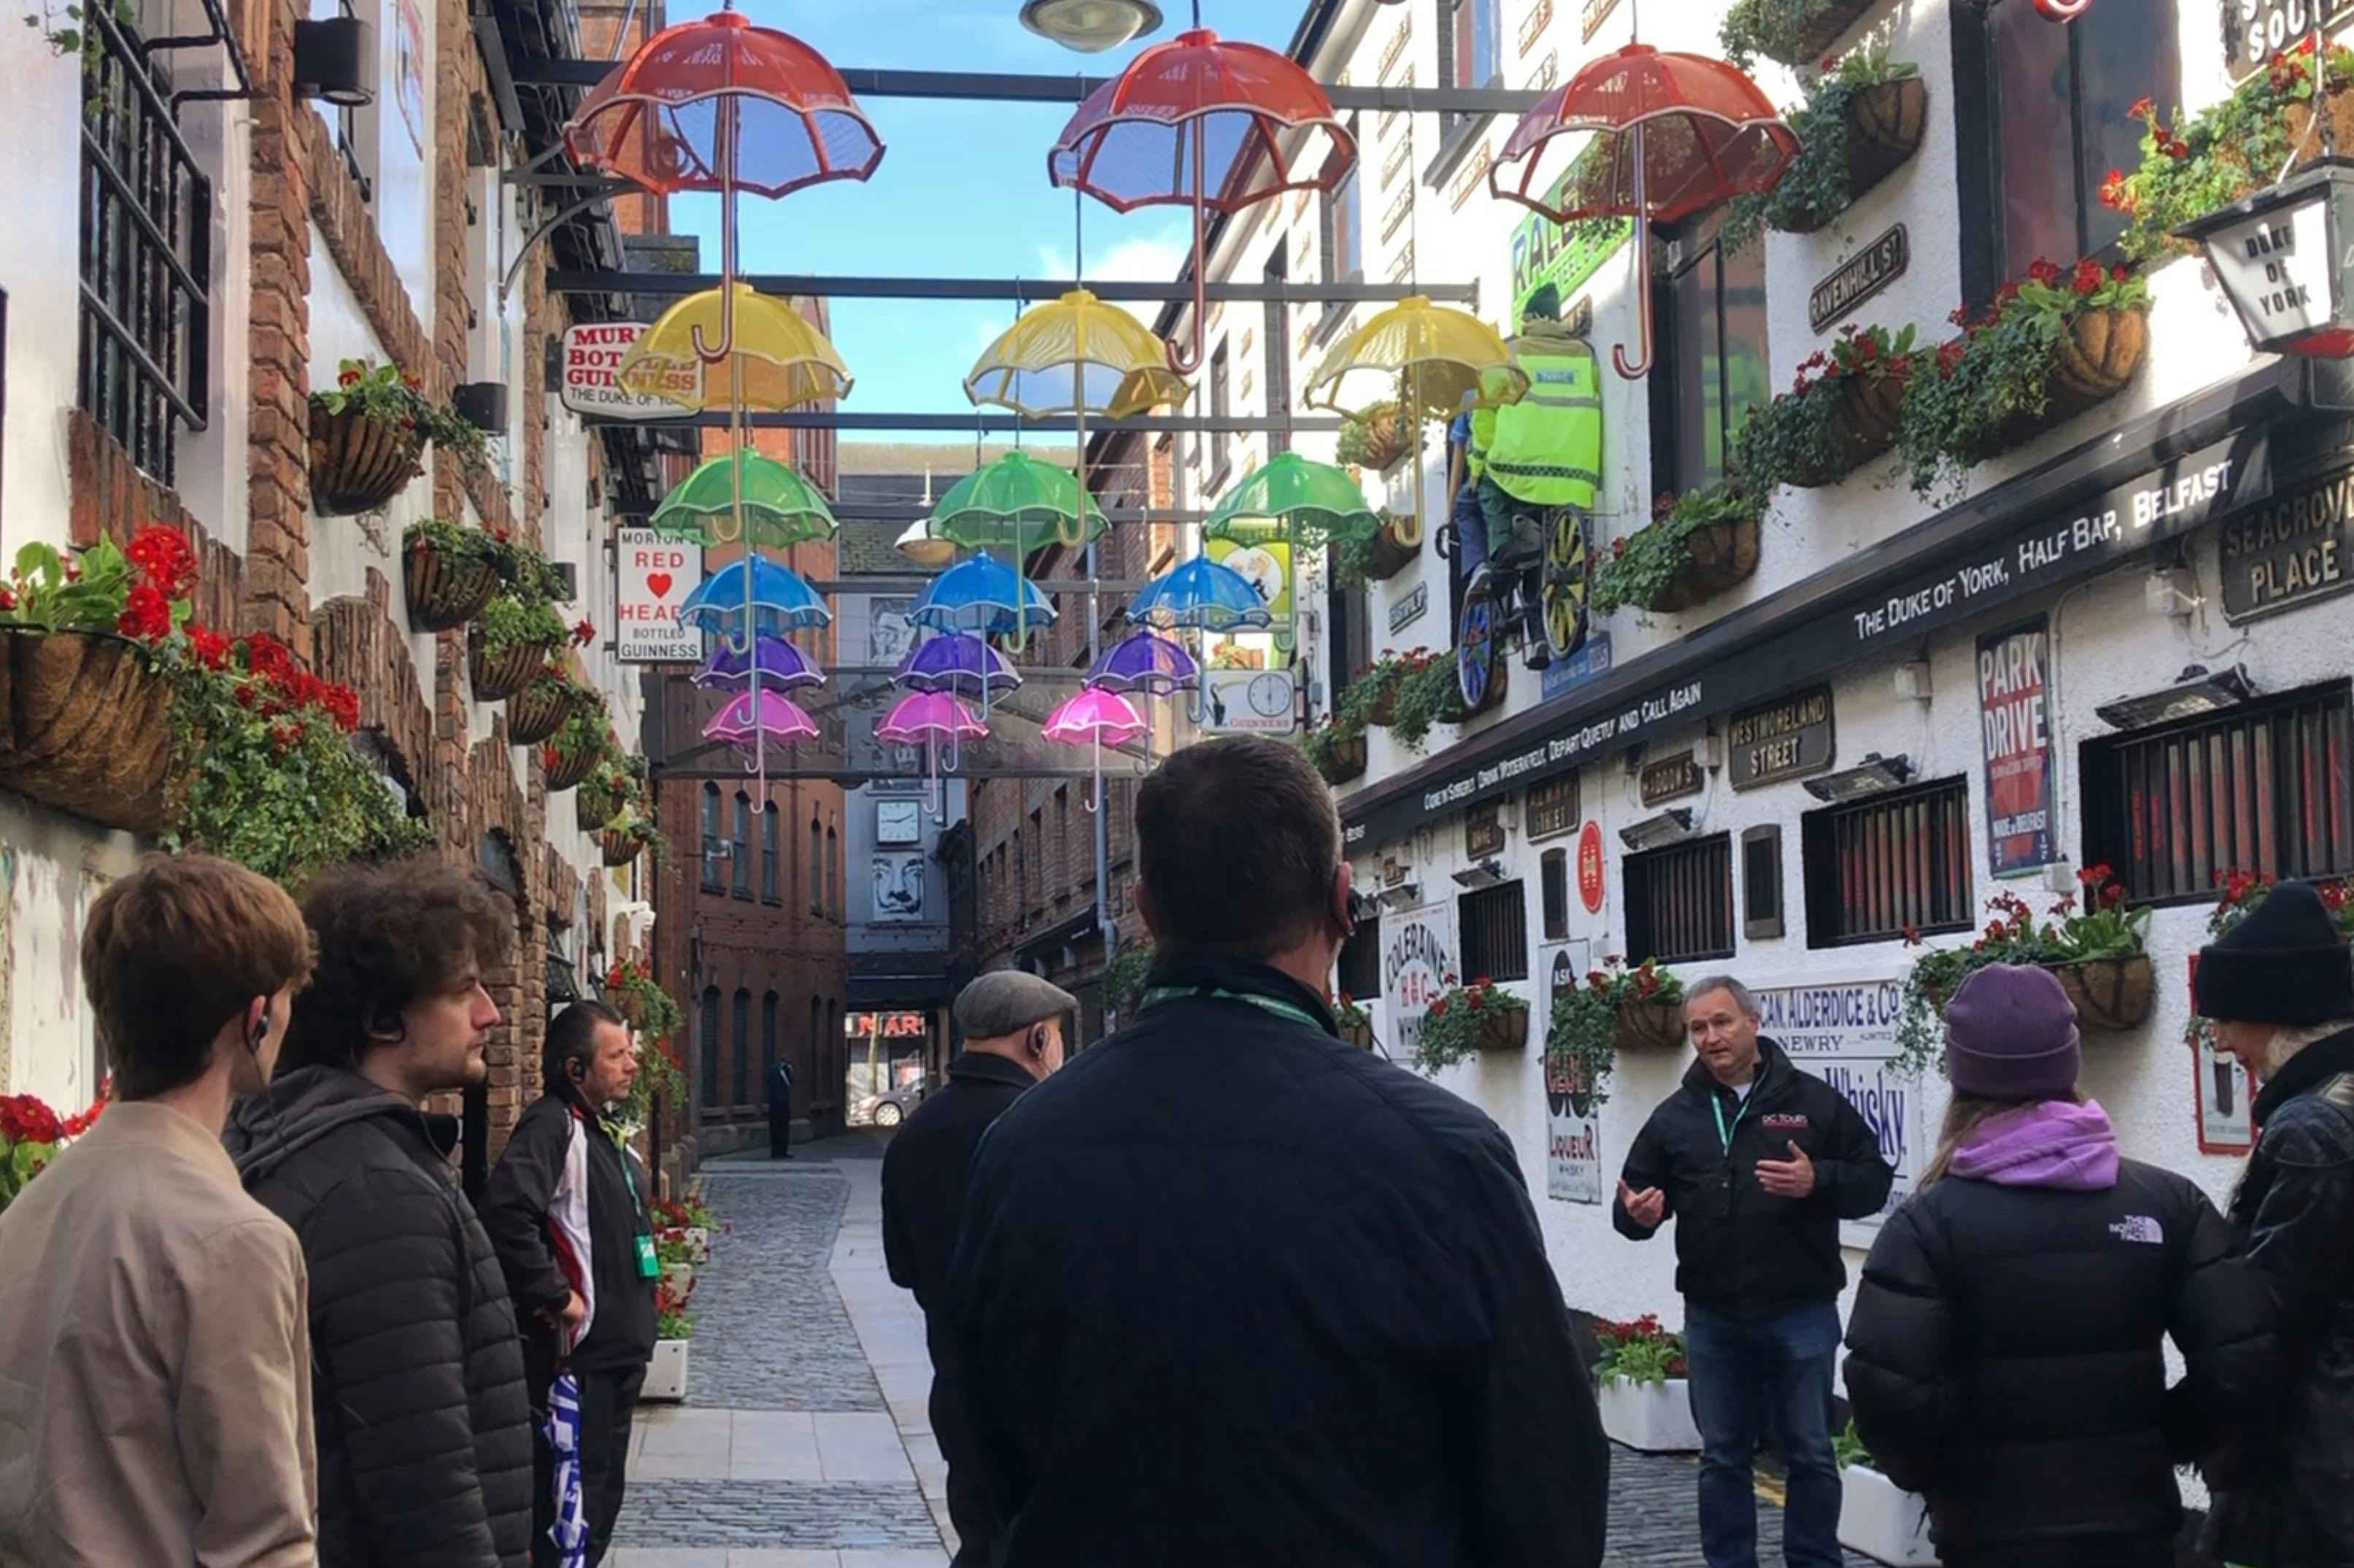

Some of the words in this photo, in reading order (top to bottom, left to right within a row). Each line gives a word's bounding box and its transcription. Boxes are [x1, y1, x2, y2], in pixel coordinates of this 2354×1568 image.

[2245, 225, 2293, 258] DUKE
[1811, 250, 1880, 316] RAVENHILL
[2266, 259, 2288, 283] OF
[2259, 284, 2312, 316] YORK
[573, 327, 649, 346] MUR
[568, 349, 694, 371] BOTLED
[567, 368, 696, 390] GUINESS
[571, 387, 595, 402] THE
[598, 390, 633, 406] DUKE
[637, 393, 656, 406] OF
[622, 532, 699, 545] MORTON
[1854, 608, 1886, 640] THE
[1887, 587, 1932, 627] DUKE
[1933, 578, 1956, 608] OF
[1958, 557, 2009, 598] YORK,
[2018, 529, 2069, 574] HALF
[2072, 510, 2122, 541] BAP,
[2132, 459, 2233, 528] BELFAST
[635, 552, 684, 568] RED
[2251, 538, 2340, 603] PLACE
[620, 605, 695, 620] HEAR
[633, 628, 685, 639] BOTTLED
[621, 644, 698, 657] GUINNESS
[1980, 632, 2042, 701] PARK
[1548, 733, 1581, 762] DEPART
[1580, 718, 1616, 749] QUIETLY
[1618, 709, 1640, 734] AND
[1642, 698, 1668, 723] CALL
[1669, 681, 1702, 714] AGAIN
[1984, 695, 2046, 760] DRIVE
[1751, 737, 1798, 775] STREET
[1788, 987, 1864, 1028] ALDERDICE
[1867, 993, 1876, 1026] &
[1778, 1035, 1844, 1051] NEWRY
[1548, 1124, 1595, 1161] LIQUEUR
